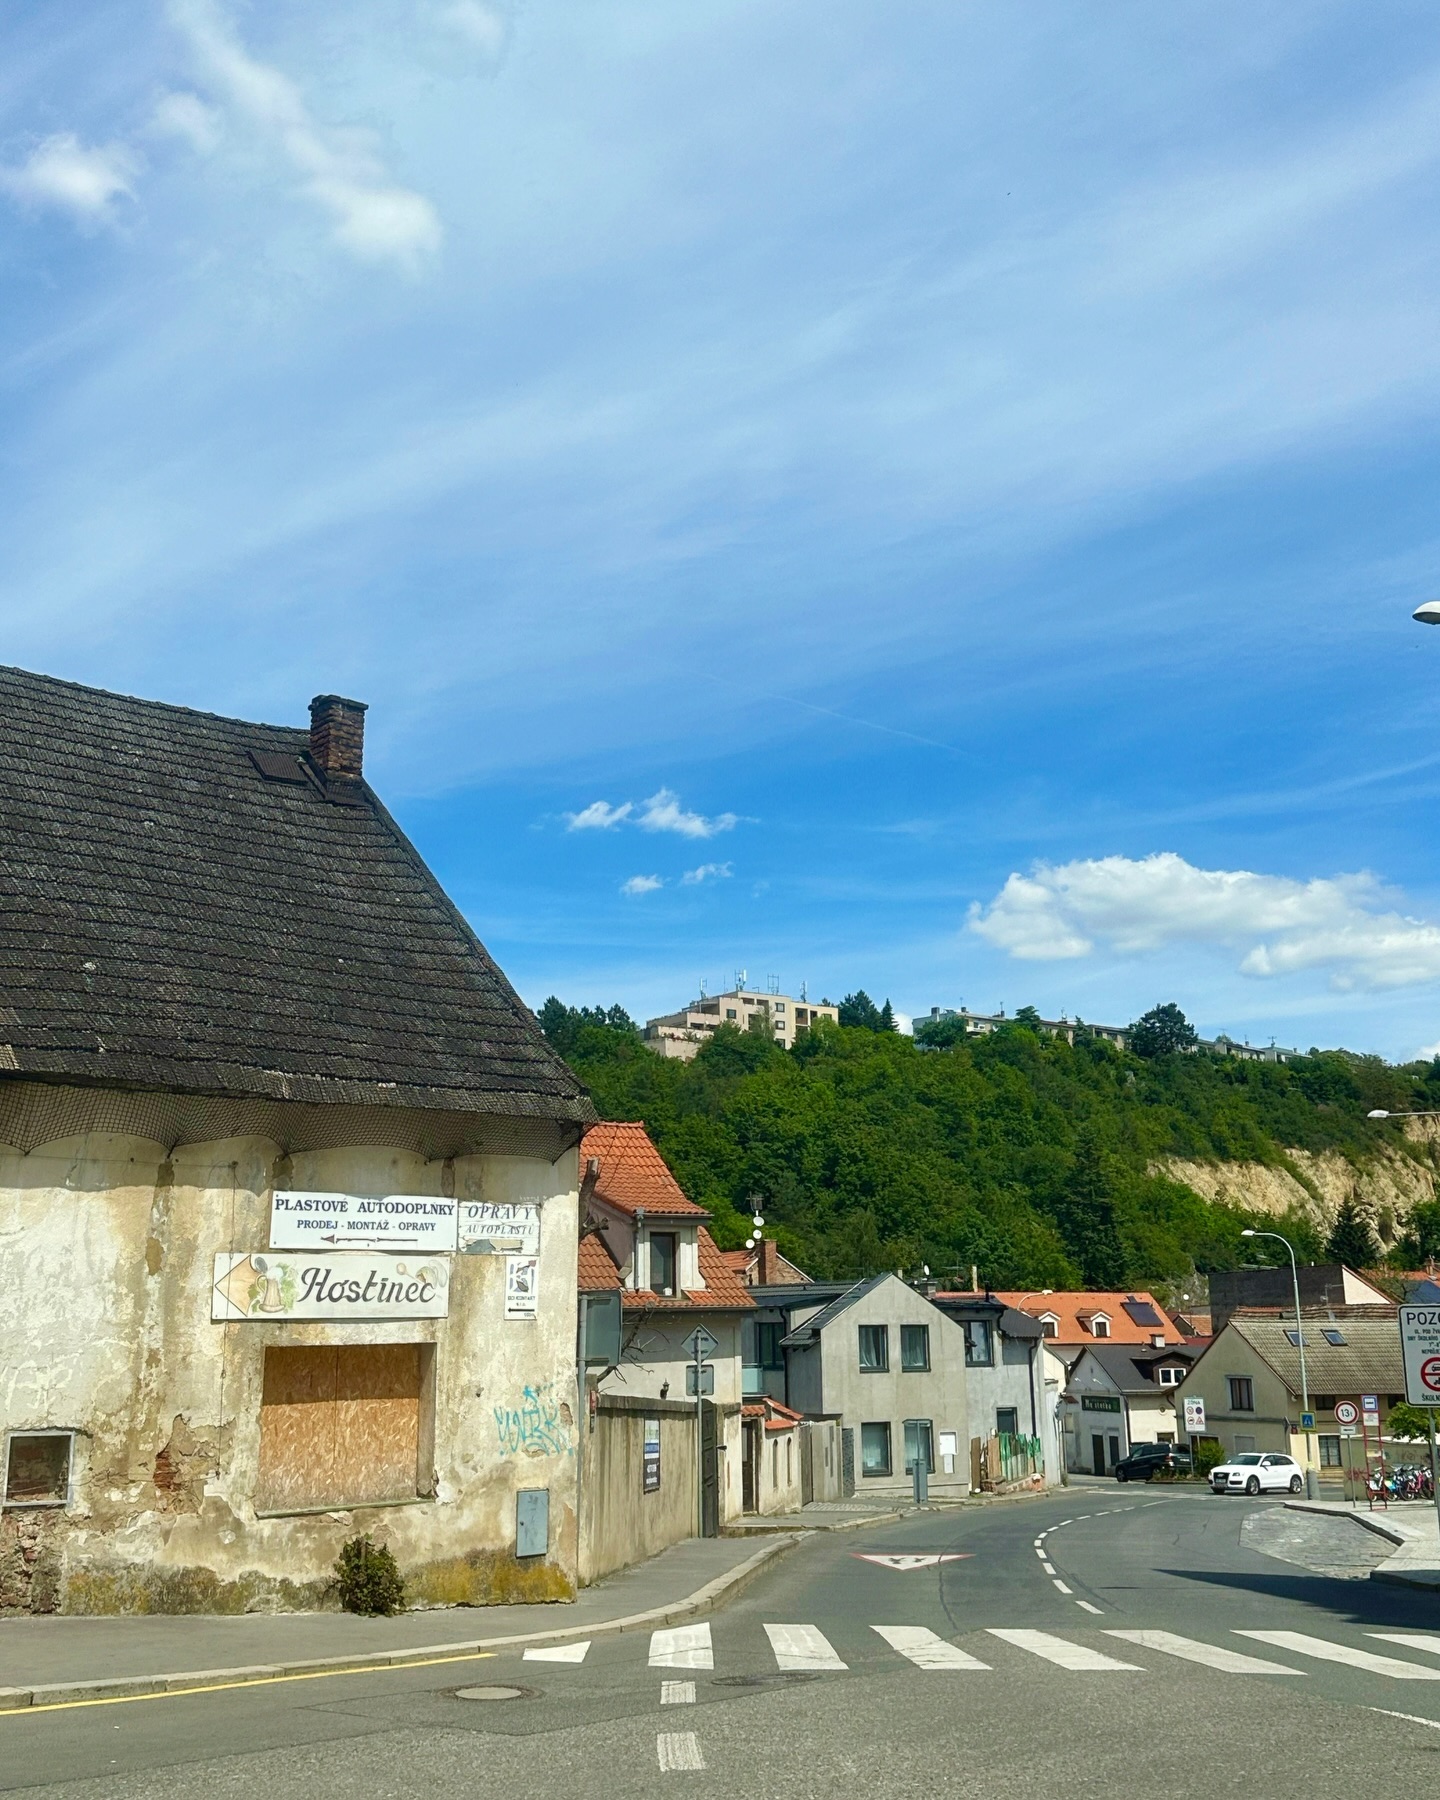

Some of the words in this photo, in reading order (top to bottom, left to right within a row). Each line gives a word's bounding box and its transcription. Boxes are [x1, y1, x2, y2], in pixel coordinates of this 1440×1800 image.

[274, 1198, 349, 1213] PLASTOVÉ
[467, 1204, 533, 1220] OPRAVY
[296, 1219, 339, 1230] PRODEJ
[346, 1219, 390, 1231] MONTÁŽ
[398, 1221, 437, 1232] OPRAVY
[296, 1267, 437, 1303] Hostinec
[1406, 1311, 1440, 1326] POZ
